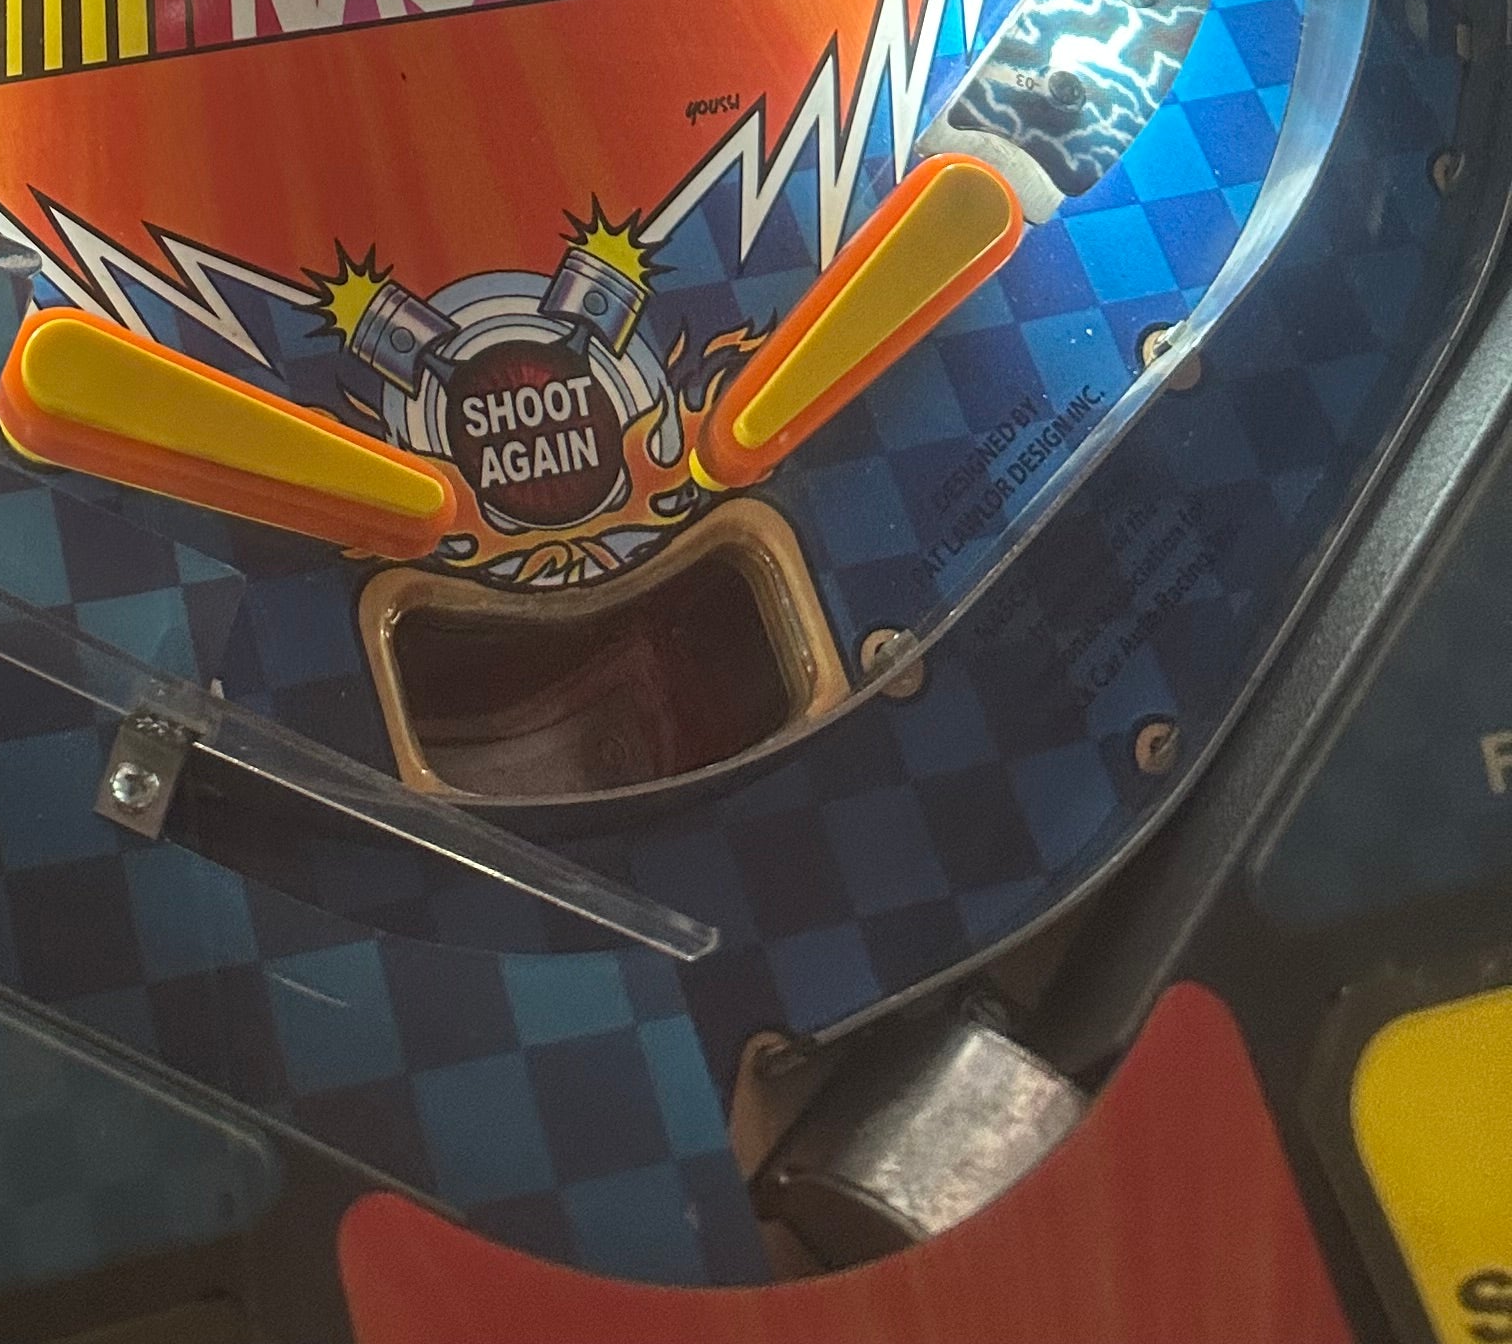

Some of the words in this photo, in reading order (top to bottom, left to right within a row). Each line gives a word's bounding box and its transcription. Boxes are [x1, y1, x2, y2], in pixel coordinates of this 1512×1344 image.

[460, 376, 593, 438] SHOOT
[1008, 417, 1070, 486] DESIGN
[1066, 383, 1106, 424] INC.
[478, 425, 599, 490] AGAIN
[935, 421, 1017, 512] DESIGNED
[1010, 396, 1042, 429] BY
